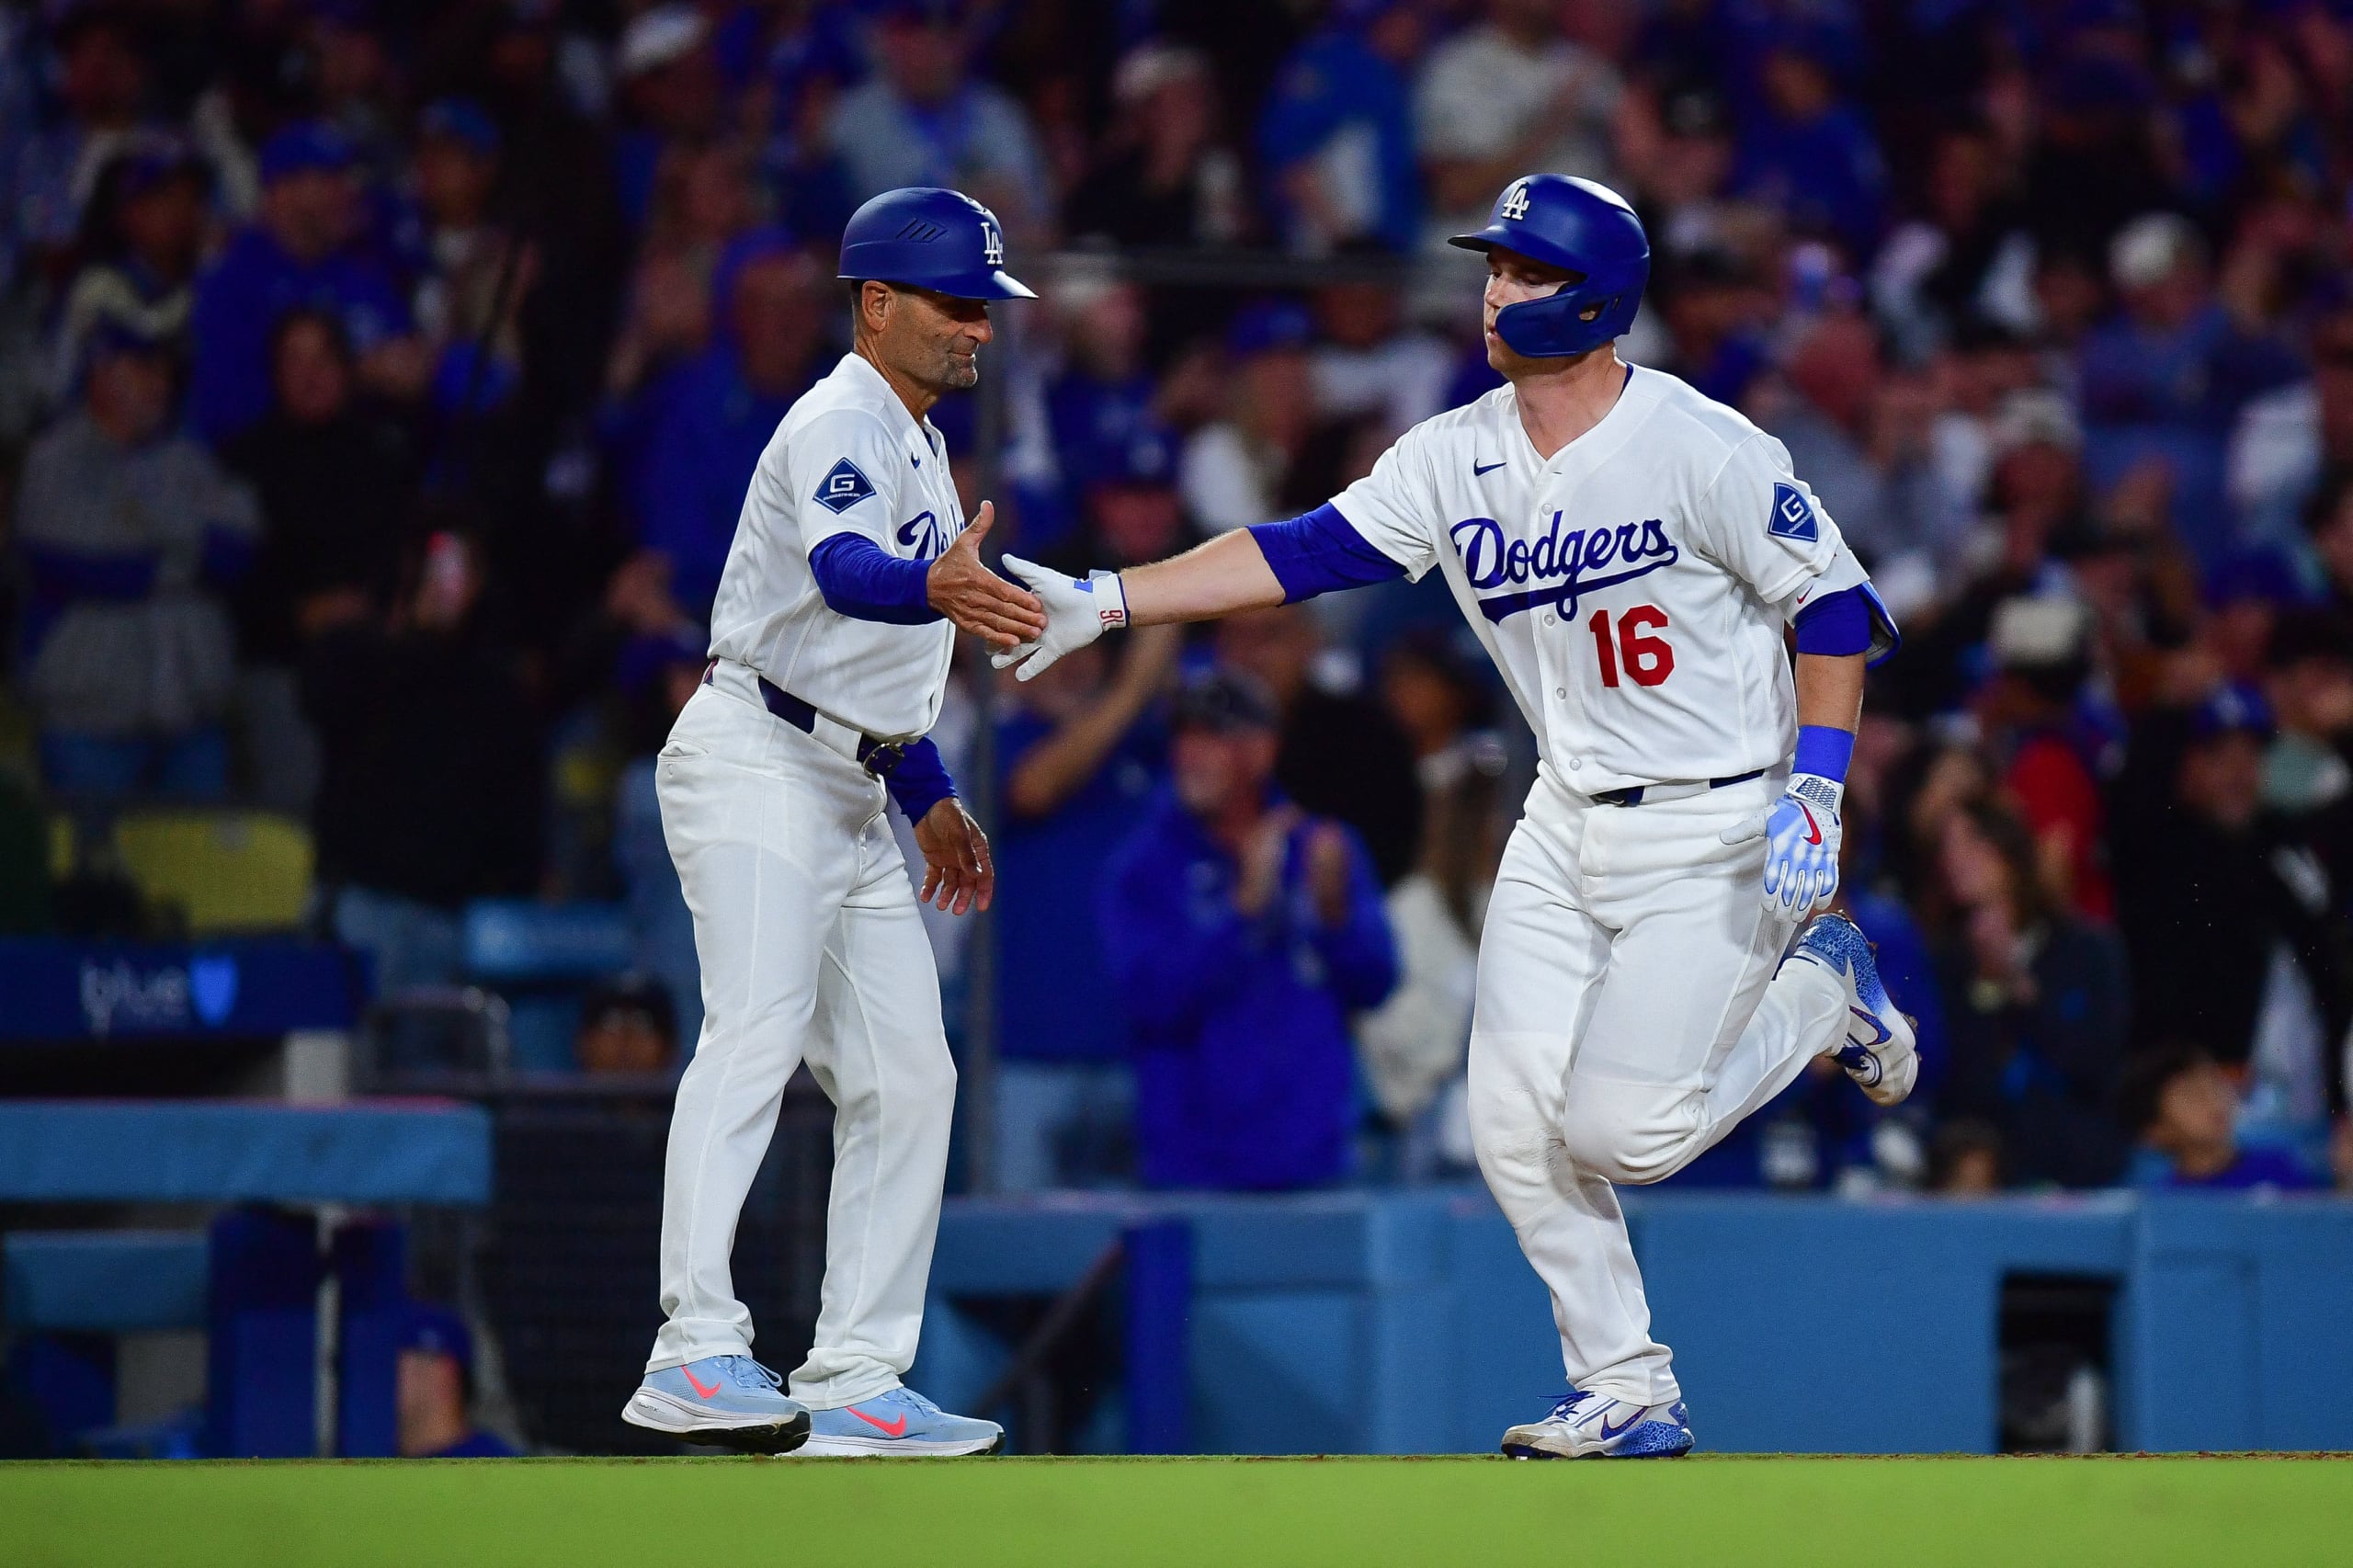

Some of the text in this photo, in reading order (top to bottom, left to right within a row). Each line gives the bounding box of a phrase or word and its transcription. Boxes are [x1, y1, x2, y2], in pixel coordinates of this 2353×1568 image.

[1501, 180, 1530, 221] LA
[981, 222, 1003, 265] LA
[829, 473, 856, 494] G
[1780, 493, 1805, 523] G
[1449, 510, 1678, 626] Dodgers
[1588, 604, 1675, 687] 16
